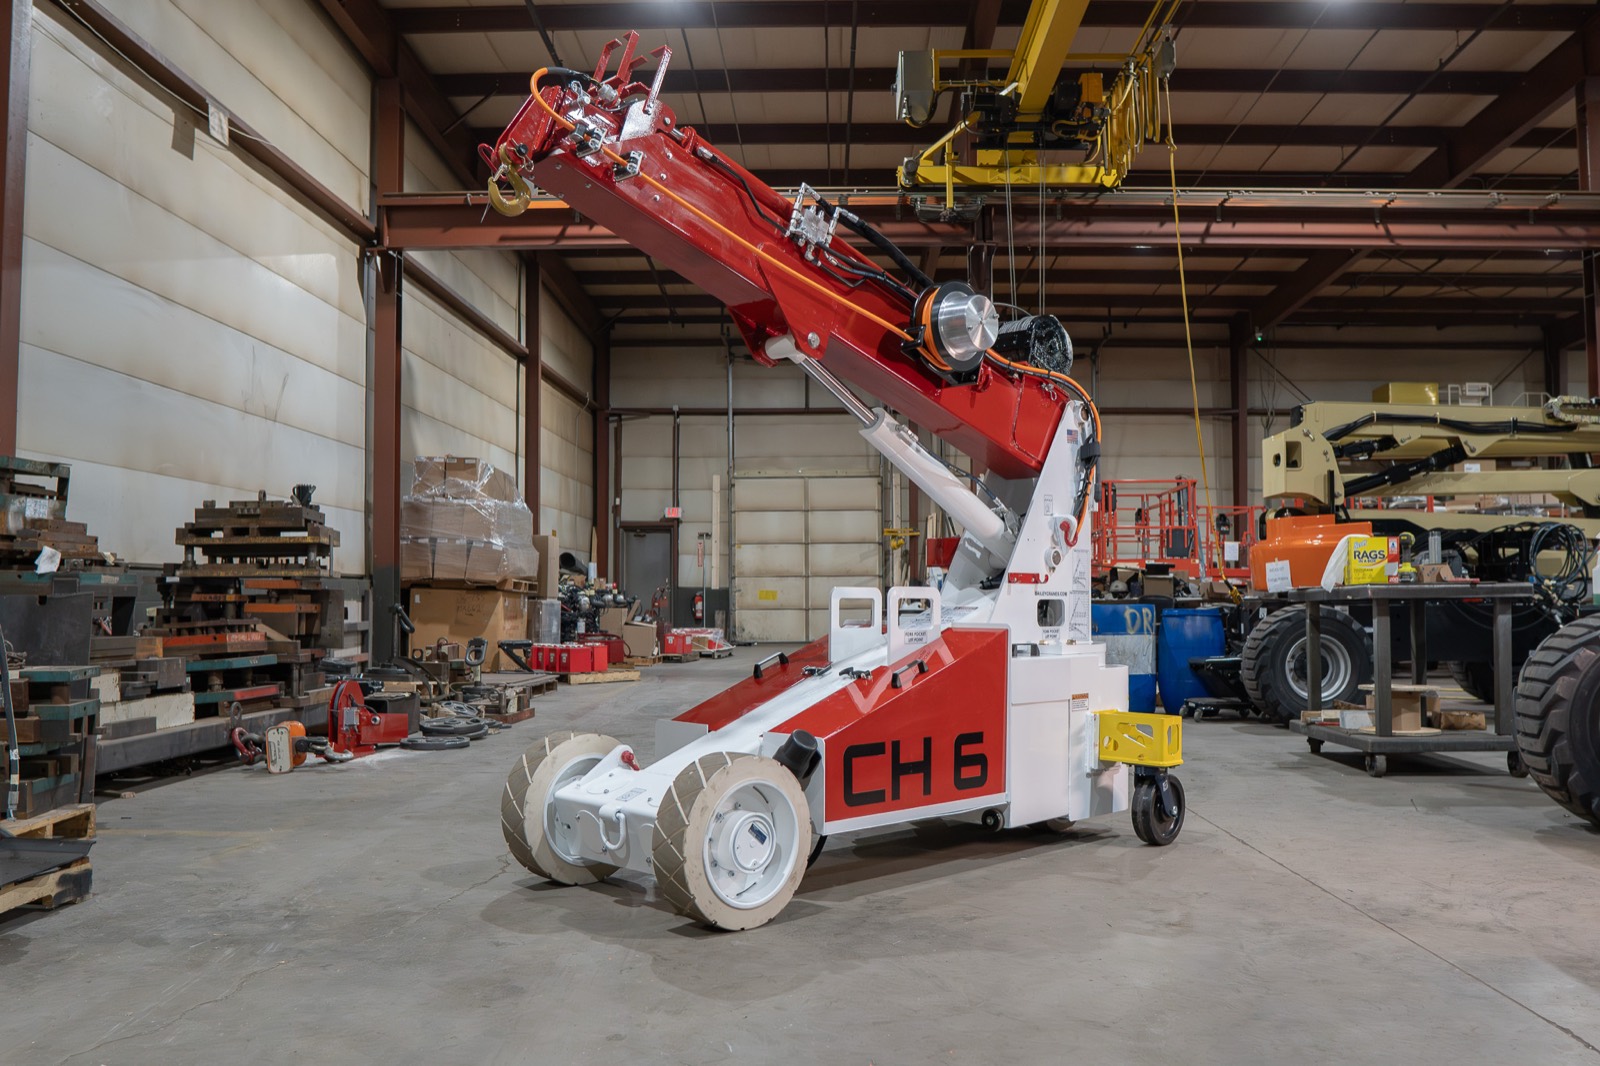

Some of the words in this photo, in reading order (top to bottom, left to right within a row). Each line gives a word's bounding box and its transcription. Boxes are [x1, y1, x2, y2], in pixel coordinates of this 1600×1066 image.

[1353, 550, 1386, 560] RAGS
[843, 736, 931, 807] CH
[954, 731, 988, 790] 6
